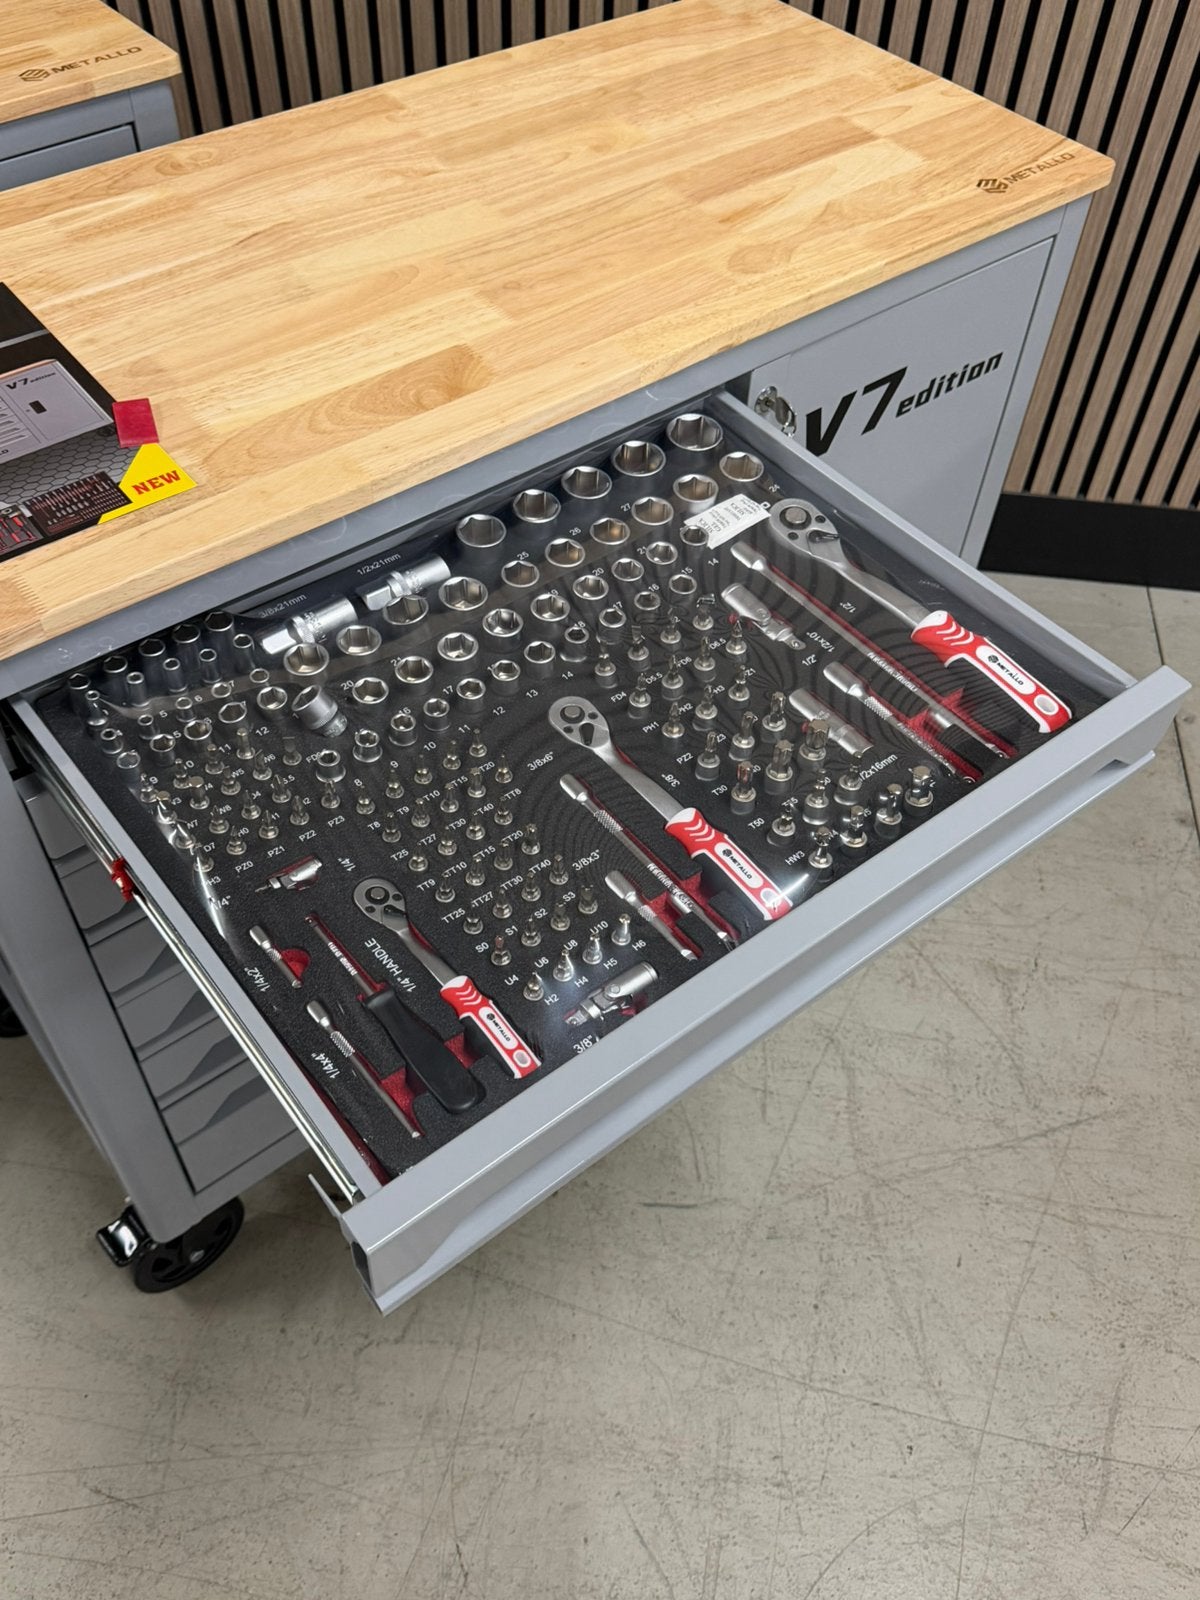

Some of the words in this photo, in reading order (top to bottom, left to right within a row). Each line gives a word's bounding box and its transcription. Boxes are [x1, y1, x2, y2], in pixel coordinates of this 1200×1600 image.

[53, 46, 142, 74] METALLO
[1005, 152, 1075, 184] METALLO
[6, 378, 29, 390] V7
[806, 366, 908, 458] V7
[896, 351, 1004, 418] edition
[132, 470, 181, 495] NEW
[569, 527, 582, 537] 26
[517, 551, 530, 561] 25
[357, 553, 401, 576] 1/2x21mm
[708, 558, 719, 567] 14
[258, 594, 308, 619] 3/8x21mm
[562, 671, 574, 681] 14
[997, 662, 1024, 686] METALLO
[340, 680, 354, 691] 20
[442, 685, 454, 696] 17
[194, 694, 202, 702] 6
[526, 689, 538, 699] 13
[610, 692, 627, 703] FD4
[159, 710, 168, 718] 5
[492, 706, 506, 716] 12
[172, 730, 182, 738] 5
[255, 726, 270, 738] 12
[458, 724, 471, 734] 11
[642, 722, 660, 734] PH1
[218, 744, 232, 754] 11
[424, 742, 437, 752] 10
[390, 760, 399, 768] 9
[527, 752, 554, 770] 3/8x6"
[676, 752, 694, 764] PZ2
[478, 762, 495, 772] T20
[859, 754, 898, 782] /2x16mm
[149, 776, 158, 784] 9
[354, 778, 363, 787] 8
[450, 776, 468, 787] T15
[661, 773, 680, 788] 3/8"
[422, 790, 441, 802] T10
[504, 788, 522, 800] TT8
[711, 785, 728, 796] T30
[396, 806, 410, 816] T9
[478, 803, 494, 814] T40
[328, 816, 346, 828] PZ3
[368, 822, 381, 831] T8
[448, 818, 467, 830] T30
[748, 818, 765, 830] T50
[298, 830, 317, 842] PZ2
[420, 834, 438, 846] T27
[267, 846, 286, 858] PZ1
[390, 849, 409, 862] T25
[784, 850, 806, 866] HW3
[235, 860, 254, 873] PZ0
[528, 859, 552, 874] TT40
[572, 850, 601, 871] 3/8x3"
[730, 856, 752, 880] METALLO
[416, 879, 436, 892] TT9
[500, 876, 524, 890] TT30
[472, 892, 494, 907] TT27
[562, 891, 576, 902] S3
[442, 908, 466, 924] TT25
[534, 908, 548, 919] S2
[505, 926, 518, 936] S1
[590, 920, 609, 934] U10
[475, 942, 489, 953] S0
[564, 940, 578, 951] U8
[632, 940, 646, 952] H6
[364, 938, 403, 976] HANDLE
[534, 956, 549, 968] U6
[603, 958, 618, 970] H5
[396, 976, 417, 992] 1/4"
[504, 974, 519, 986] U4
[574, 976, 589, 988] H4
[544, 994, 560, 1006] H2
[492, 1020, 510, 1042] METALLO
[573, 1034, 593, 1055] 3/8"
